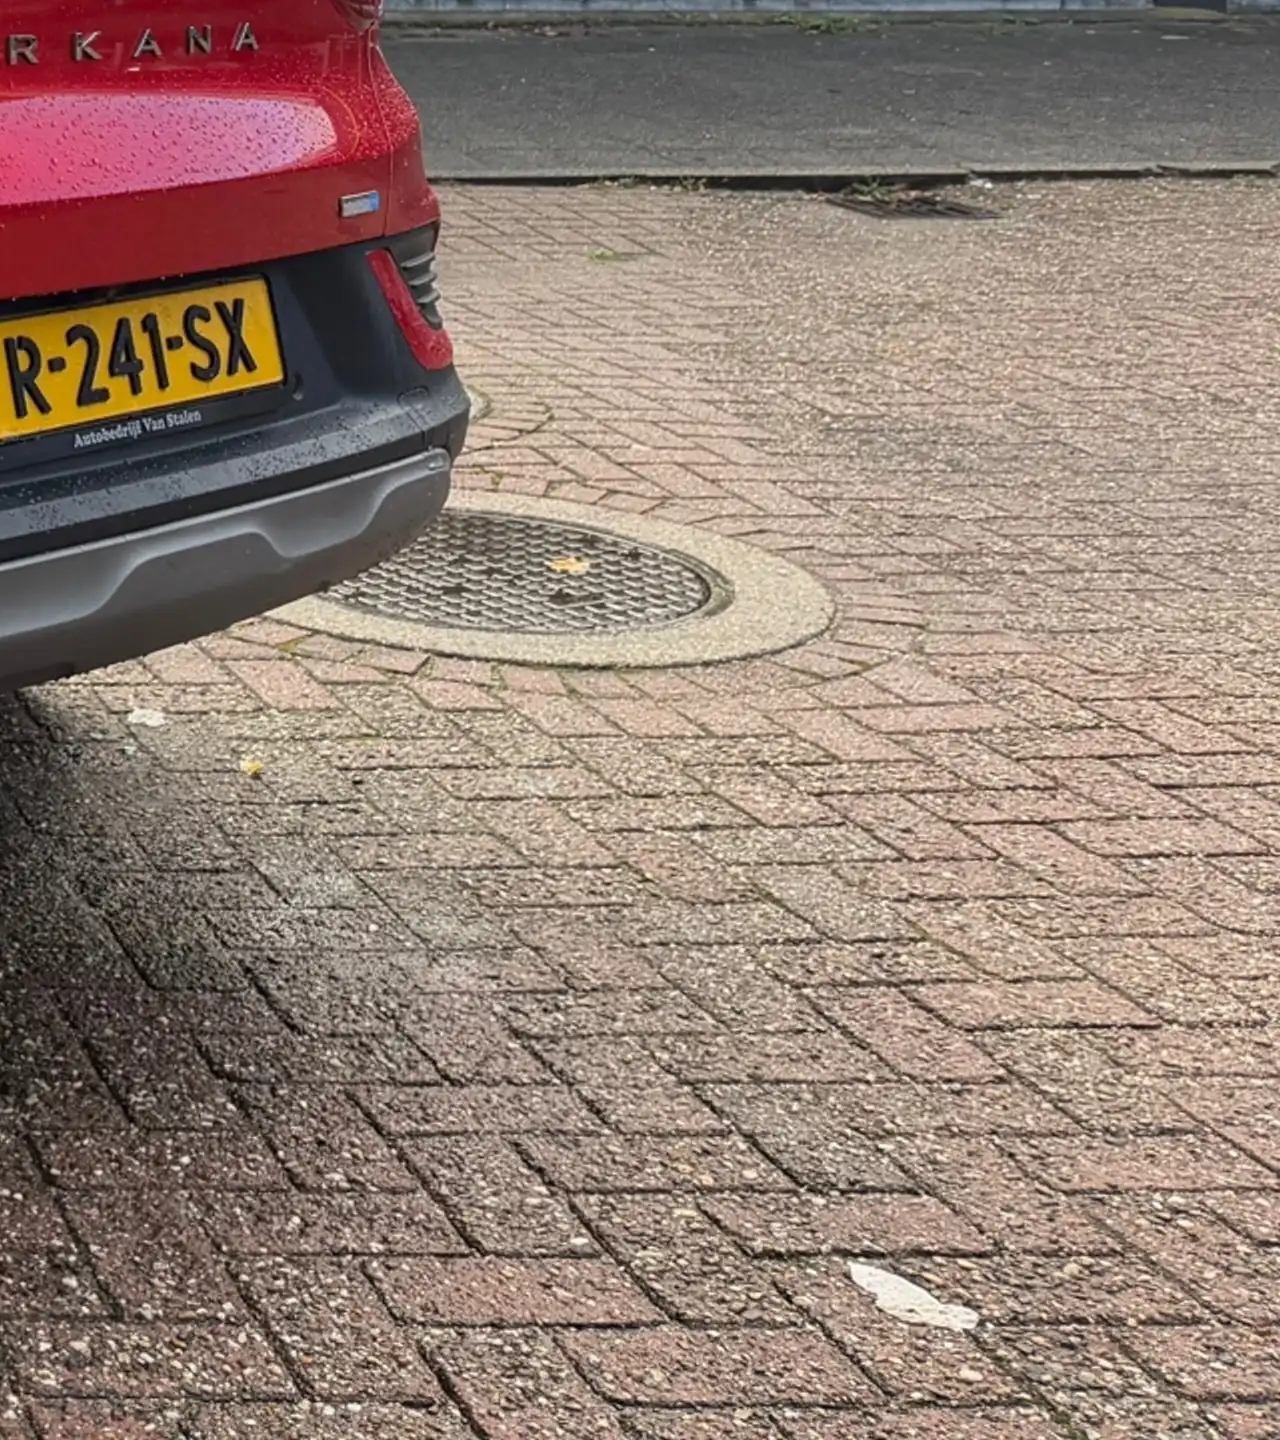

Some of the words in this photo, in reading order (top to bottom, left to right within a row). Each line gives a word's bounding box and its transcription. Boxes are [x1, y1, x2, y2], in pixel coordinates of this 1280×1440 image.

[4, 298, 258, 420] R-241-SX
[73, 420, 143, 449] Autobedrijf
[142, 417, 166, 435] Van
[166, 408, 203, 428] Stalen
